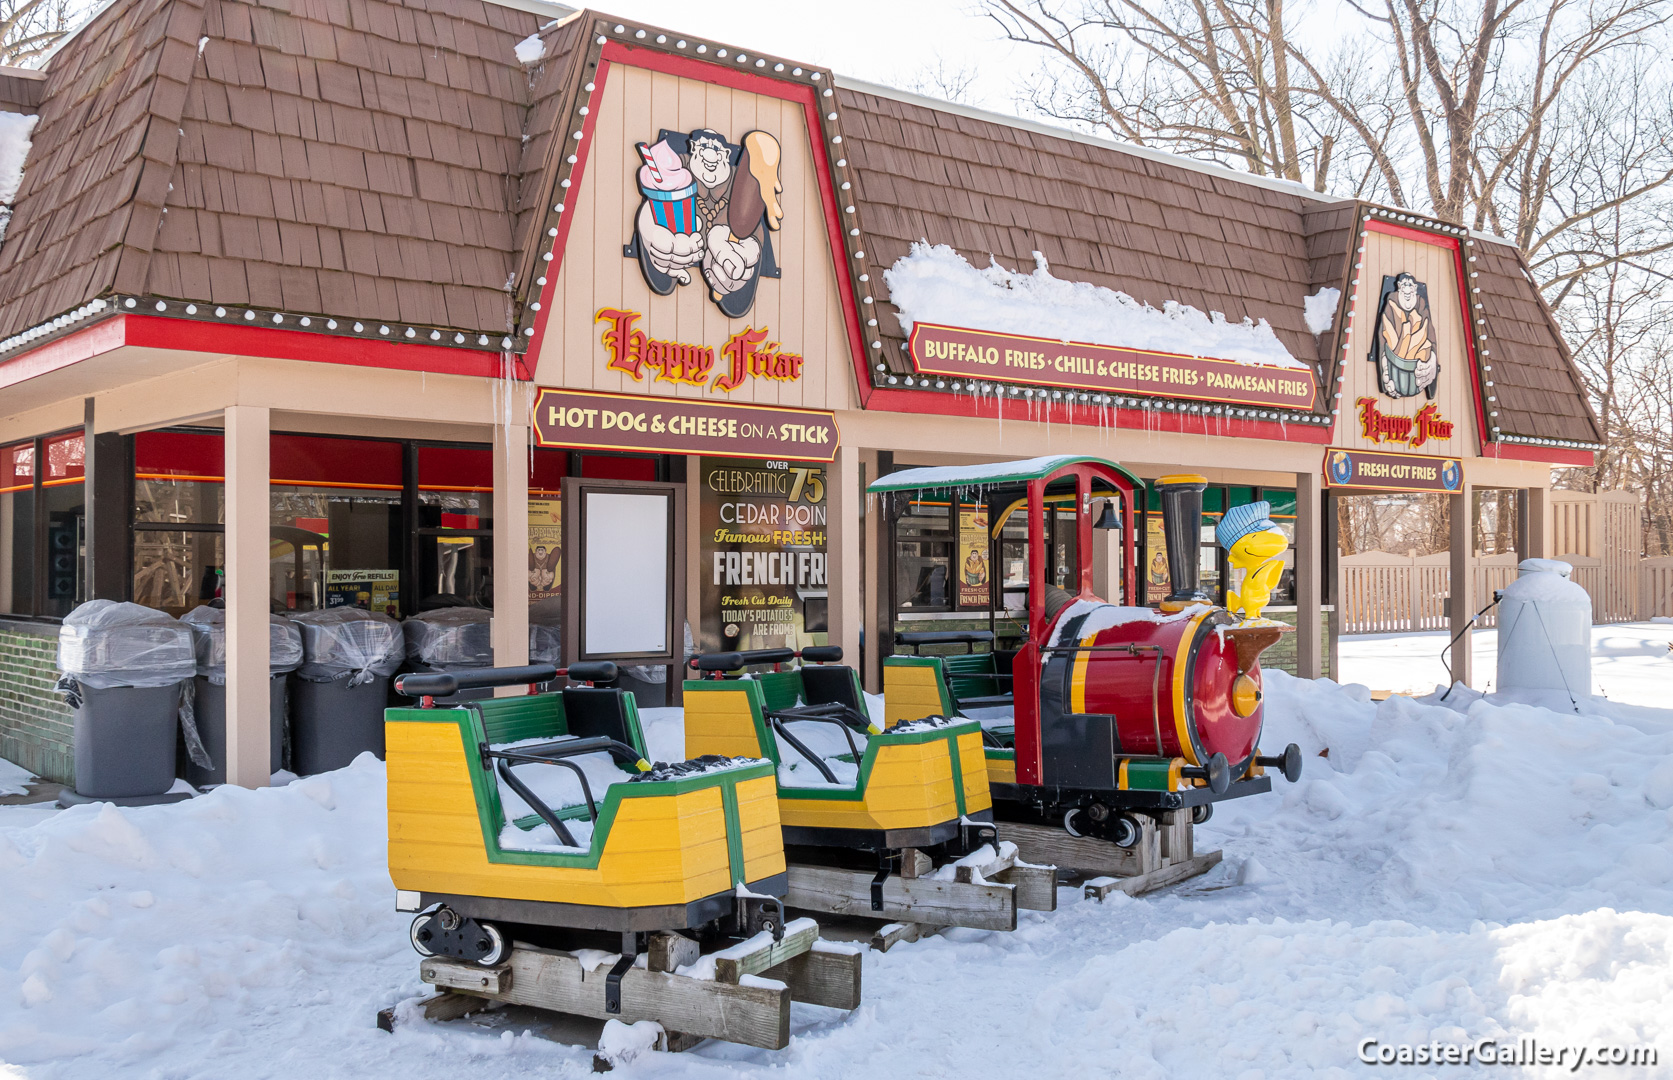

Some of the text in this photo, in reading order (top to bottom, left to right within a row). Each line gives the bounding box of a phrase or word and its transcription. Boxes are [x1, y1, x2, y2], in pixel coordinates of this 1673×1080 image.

[595, 307, 804, 393] Happy Friar
[925, 340, 1308, 397] BUFFALO FRIES CHILI & CHEESE FRIES PARMESAN FRIES
[549, 406, 829, 444] HOT DOG & CHEESE ON A STICK
[1355, 396, 1454, 449] Happy Friar
[766, 461, 788, 470] OVER
[1358, 462, 1389, 478] FRESH
[1391, 465, 1410, 479] CUT
[1411, 466, 1437, 481] FRIES
[708, 468, 824, 504] CELEBRATING 75
[720, 502, 826, 526] CEDAR POIN
[714, 529, 827, 546] Famous FRESH-
[331, 573, 352, 581] ENJOY
[352, 571, 366, 581] Free
[713, 552, 828, 586] FRENCH FRI
[721, 595, 793, 607] Fresh Cut Daily
[722, 610, 793, 622] TODAY'S POTATOES
[752, 624, 768, 636] ARE
